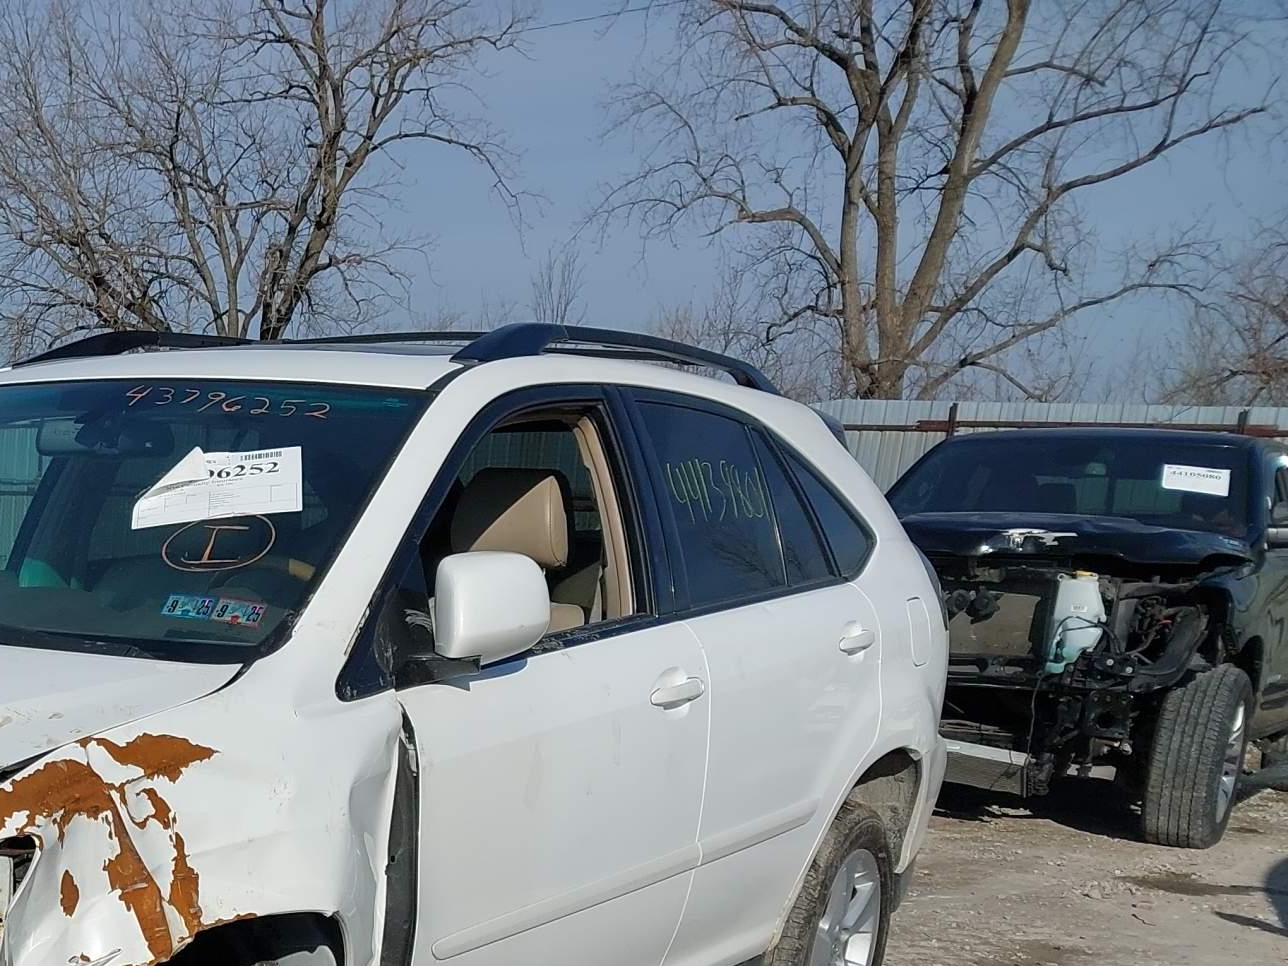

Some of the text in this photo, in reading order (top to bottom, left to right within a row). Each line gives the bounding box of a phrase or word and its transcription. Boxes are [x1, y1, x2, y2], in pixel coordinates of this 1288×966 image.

[126, 384, 332, 420] 43796252
[196, 598, 214, 616] 25
[246, 605, 265, 622] 25
